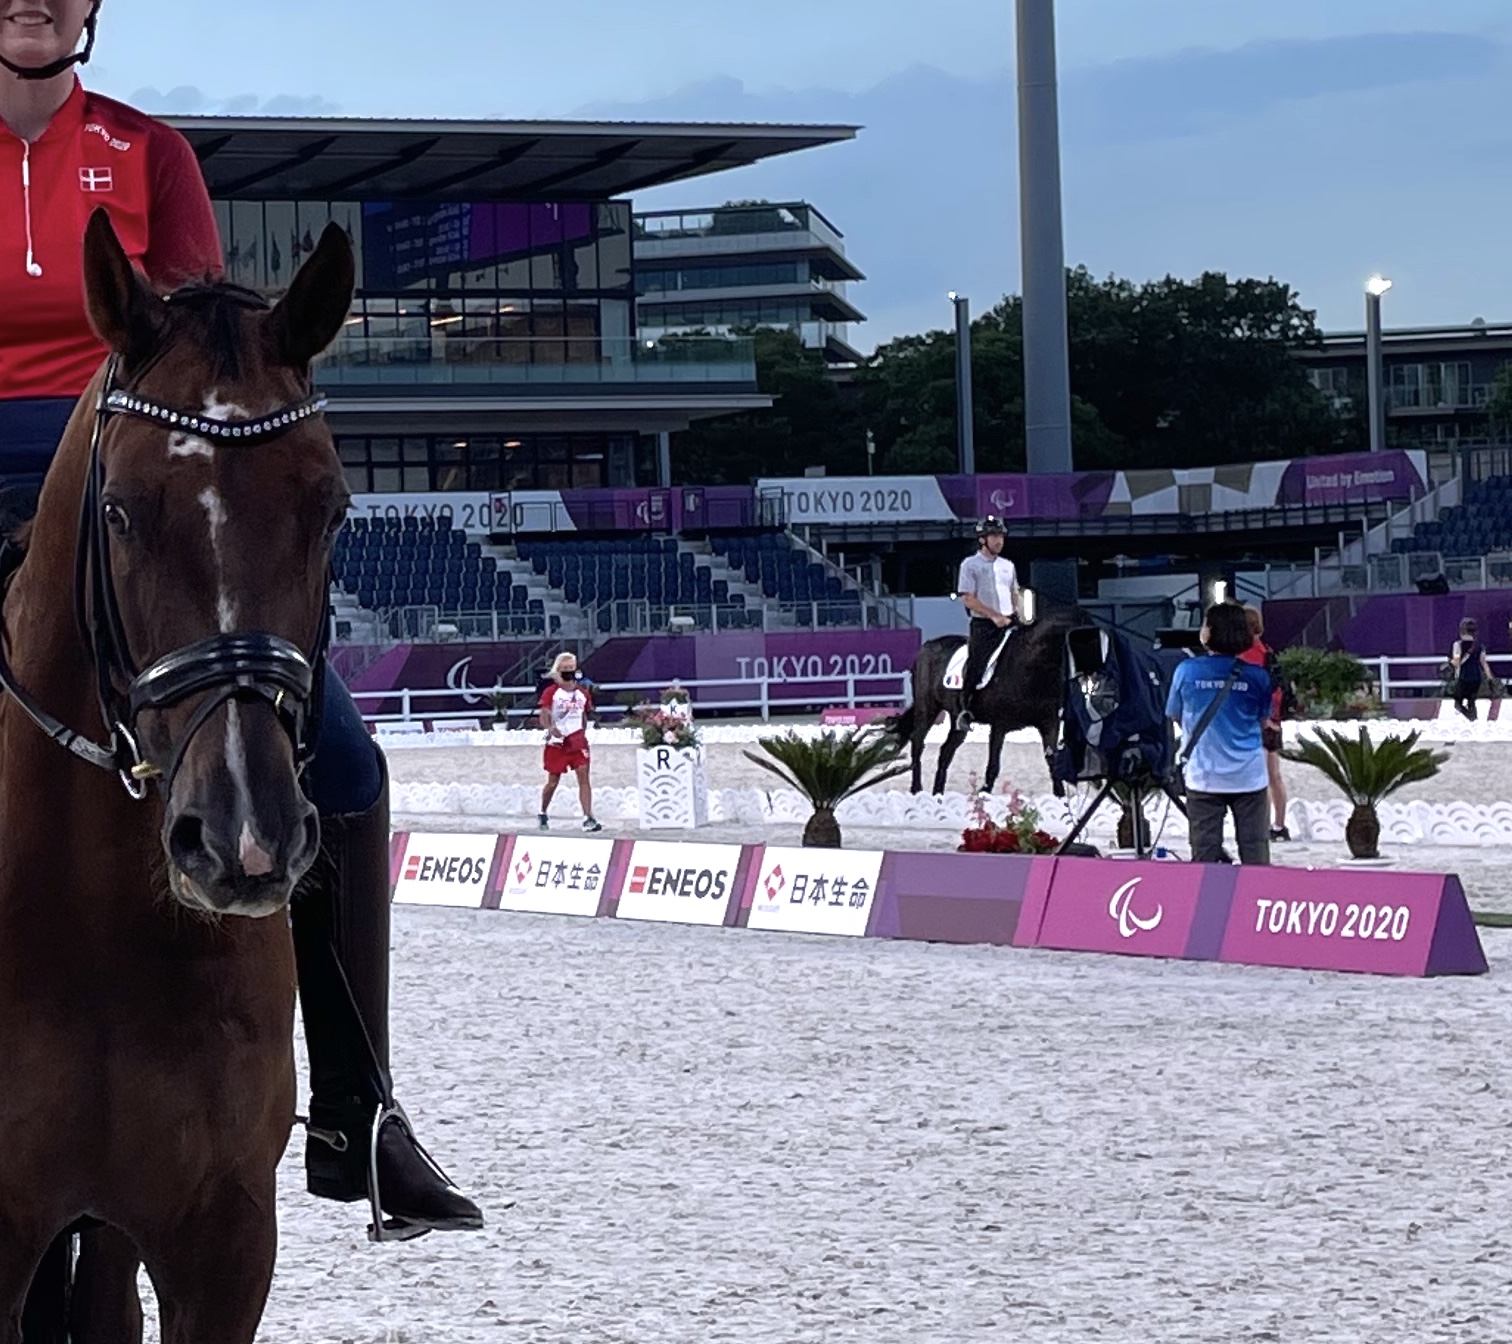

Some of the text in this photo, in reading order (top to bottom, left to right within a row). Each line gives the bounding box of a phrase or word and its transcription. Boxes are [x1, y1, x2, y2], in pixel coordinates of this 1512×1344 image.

[783, 489, 912, 513] TOKYO 2020
[736, 654, 892, 679] TOKYO 2020
[657, 749, 671, 769] R
[419, 856, 486, 884] ENEOS
[535, 860, 602, 891] 日本生命
[647, 867, 729, 900] ENEOS
[790, 873, 870, 909] 日本生命
[1256, 899, 1409, 940] TOKYO 2020
